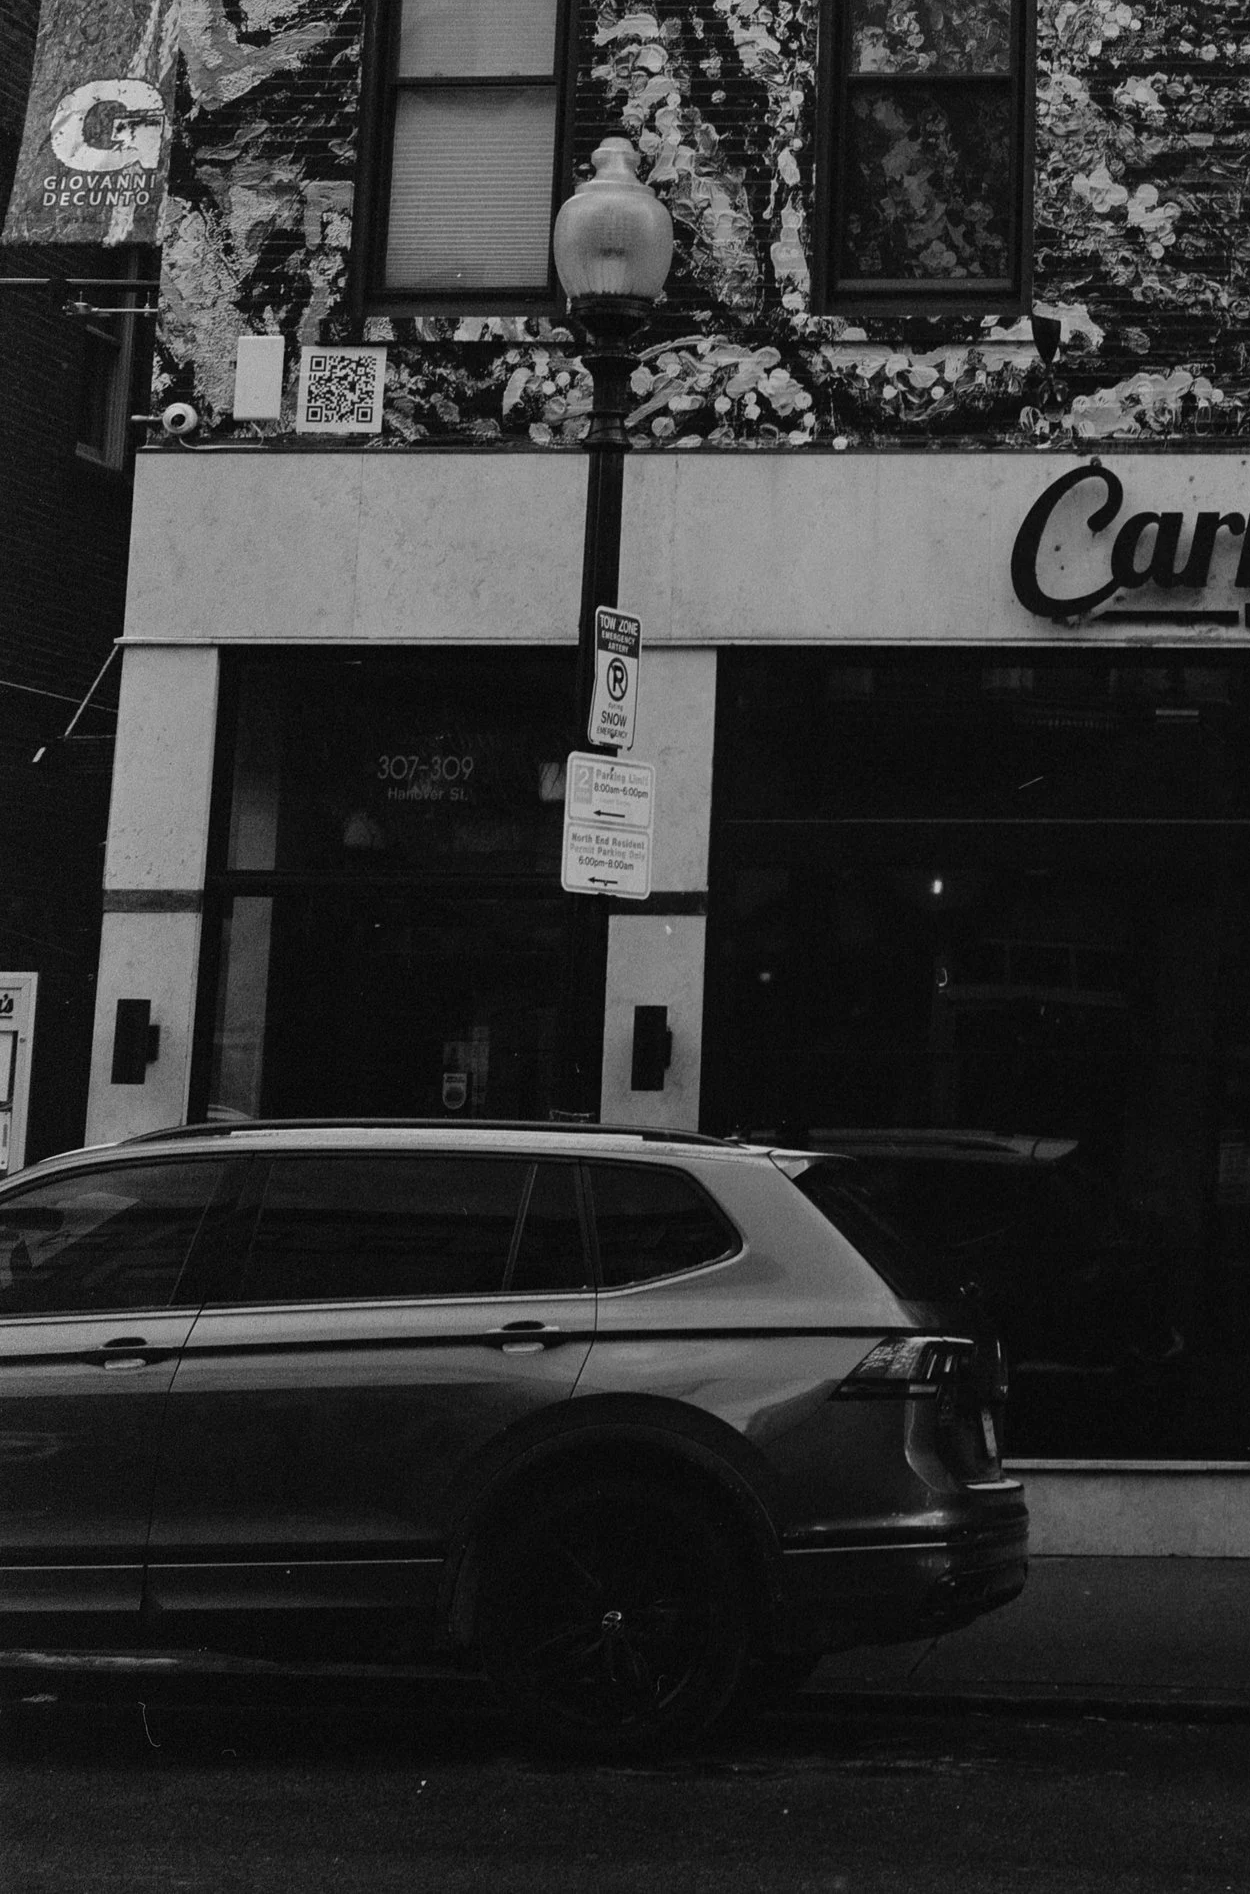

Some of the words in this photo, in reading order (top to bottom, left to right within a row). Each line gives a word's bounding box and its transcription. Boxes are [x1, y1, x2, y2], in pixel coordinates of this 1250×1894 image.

[43, 174, 156, 191] GIOVANNI
[42, 190, 150, 207] DECUNTO
[599, 614, 616, 631] TOW
[618, 620, 639, 636] ZONE
[601, 630, 636, 646] EMERGENCY
[607, 642, 629, 654] ARTERY
[601, 710, 627, 728] SNOW
[596, 725, 628, 740] EMERGENCY
[377, 755, 474, 780] 307-309
[578, 768, 590, 787] 2
[596, 768, 626, 785] Parking
[387, 786, 445, 801] Hanover
[449, 787, 469, 802] St.
[571, 833, 593, 843] North
[595, 835, 609, 845] End
[612, 837, 645, 850] Resident
[570, 843, 595, 855] Permit
[597, 846, 626, 859] Parking
